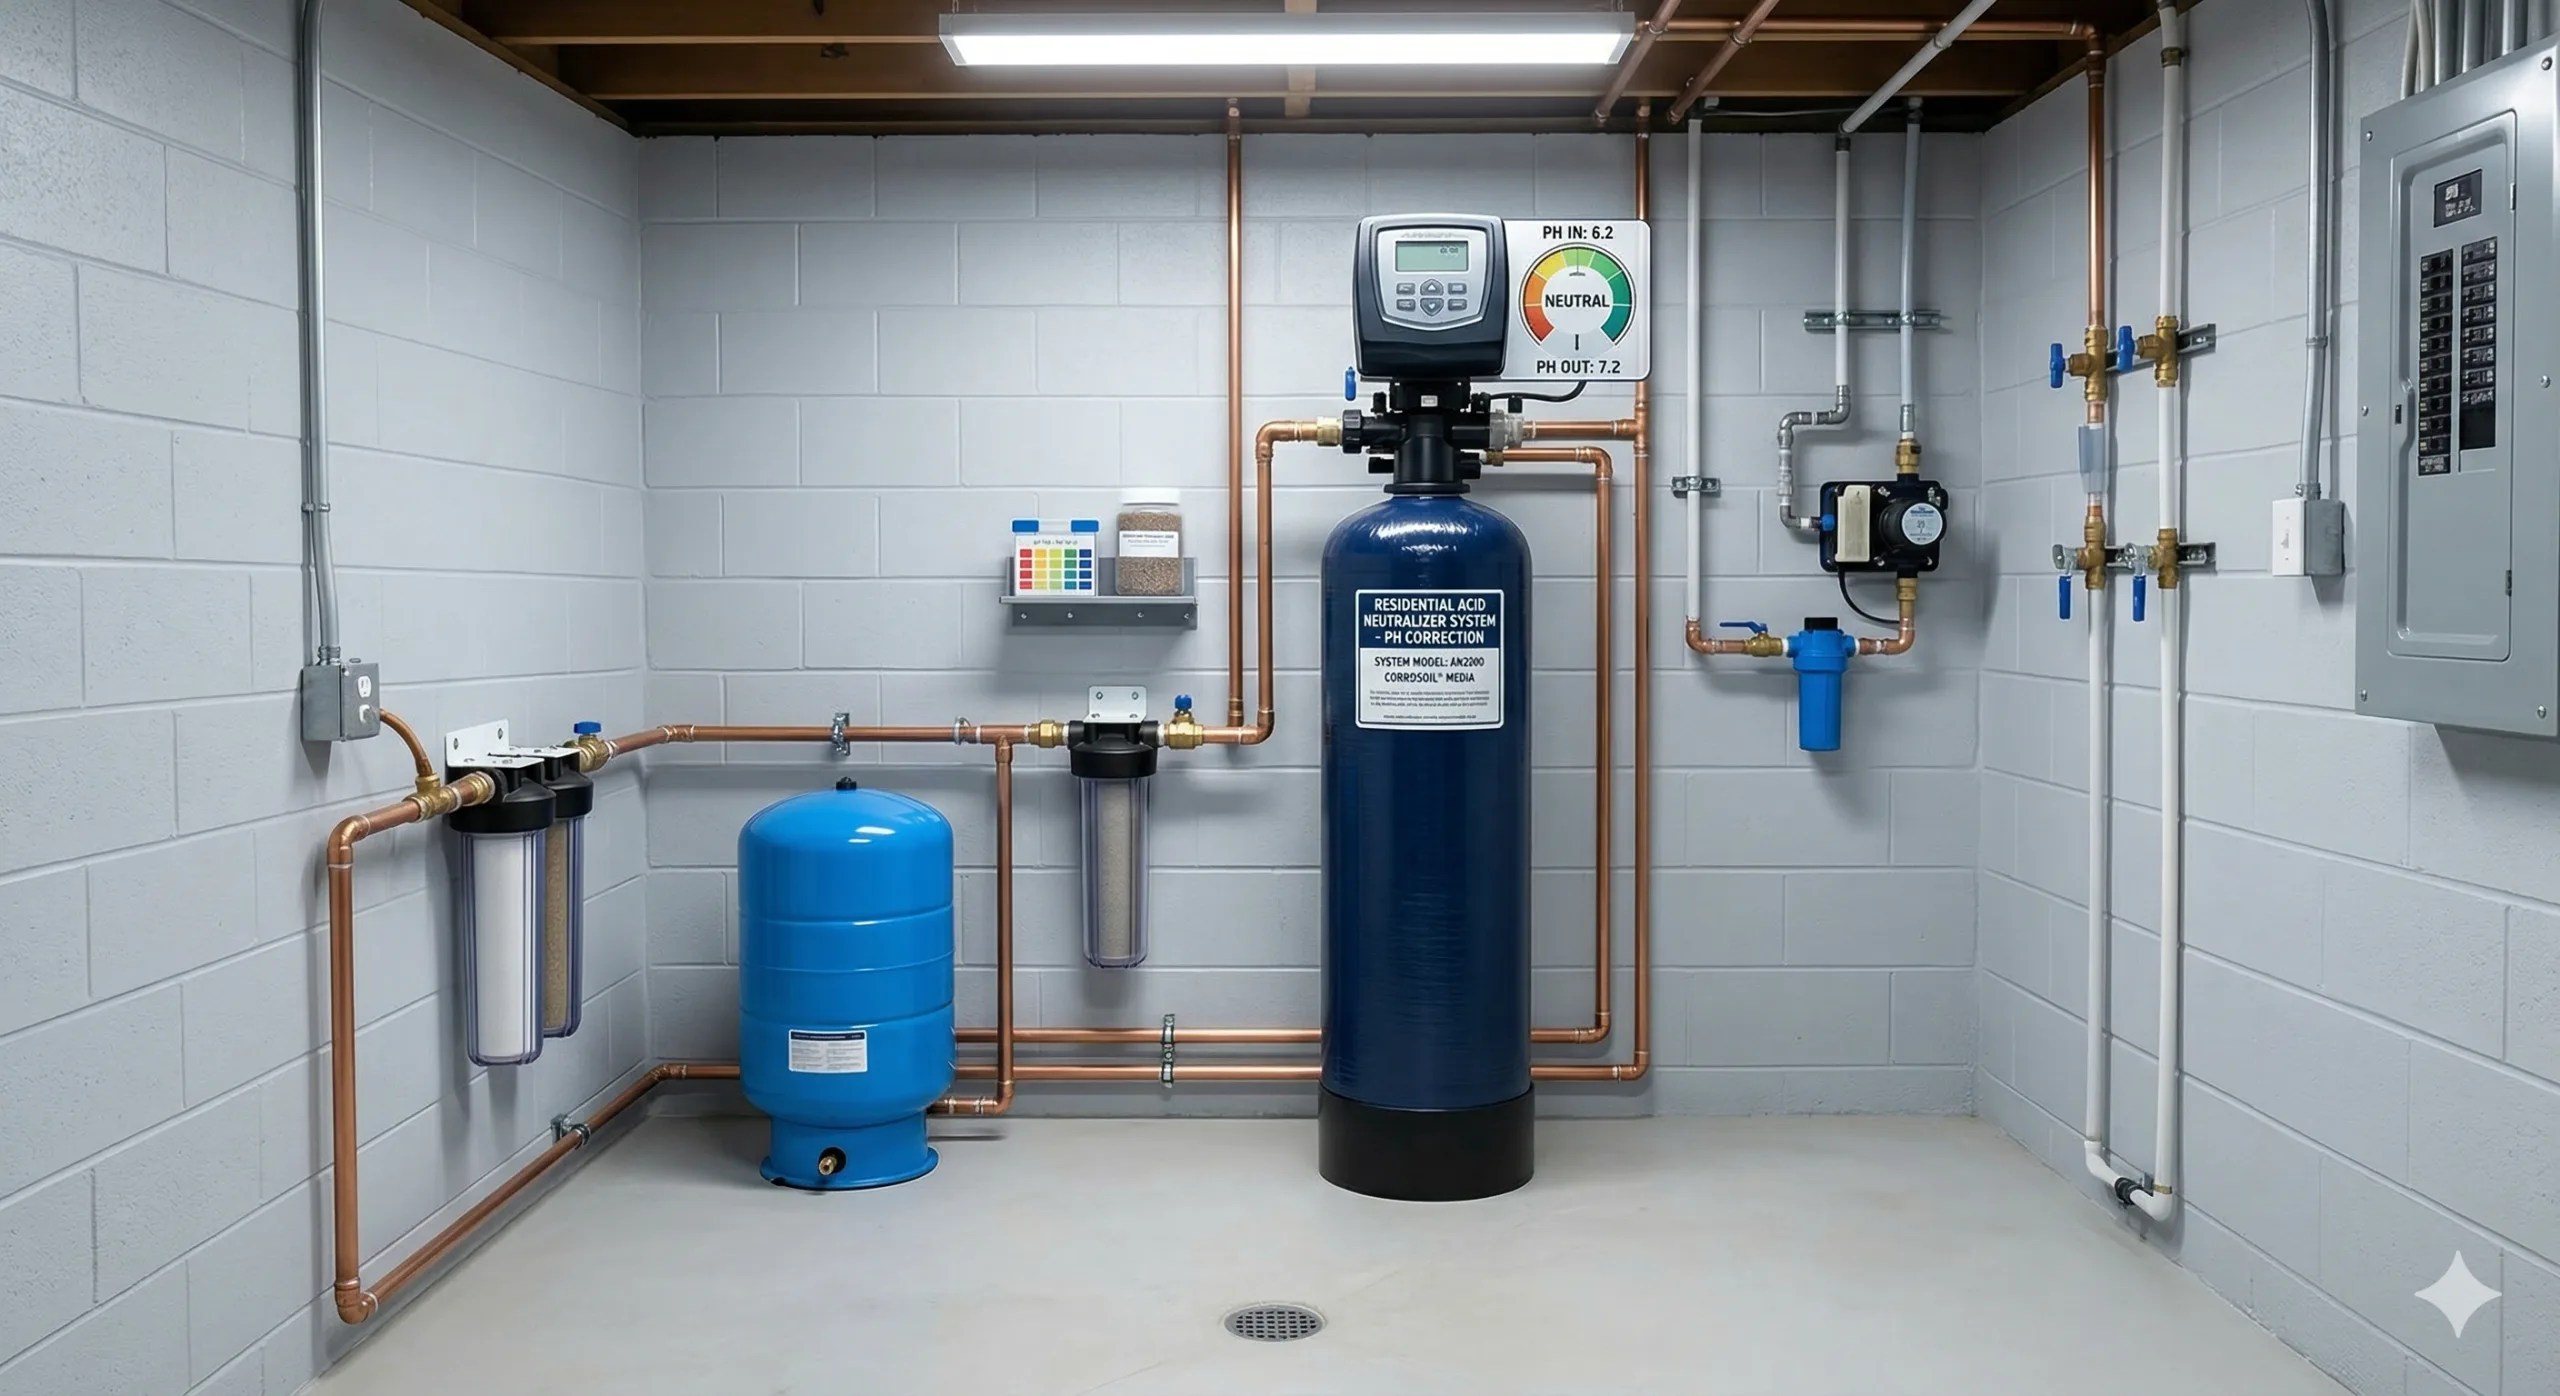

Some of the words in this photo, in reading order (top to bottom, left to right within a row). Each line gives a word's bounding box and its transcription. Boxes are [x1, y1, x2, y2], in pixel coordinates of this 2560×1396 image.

[1543, 225, 1562, 240] PH
[1568, 225, 1587, 240] IN:
[1592, 225, 1614, 240] 6.2
[1545, 294, 1610, 308] NEUTRAL
[1536, 360, 1556, 374] PH
[1562, 360, 1594, 374] OUT:
[1598, 360, 1620, 374] 7.2
[1374, 598, 1454, 612] RESIDENTIAL
[1457, 598, 1486, 612] ACID
[1363, 614, 1447, 628] NEUTRALIZER
[1449, 614, 1496, 628] SYSTEM
[1384, 630, 1402, 644] PH
[1405, 630, 1484, 644] CORRECTION
[1374, 656, 1410, 667] SYSTEM
[1412, 656, 1449, 667] MODEL:
